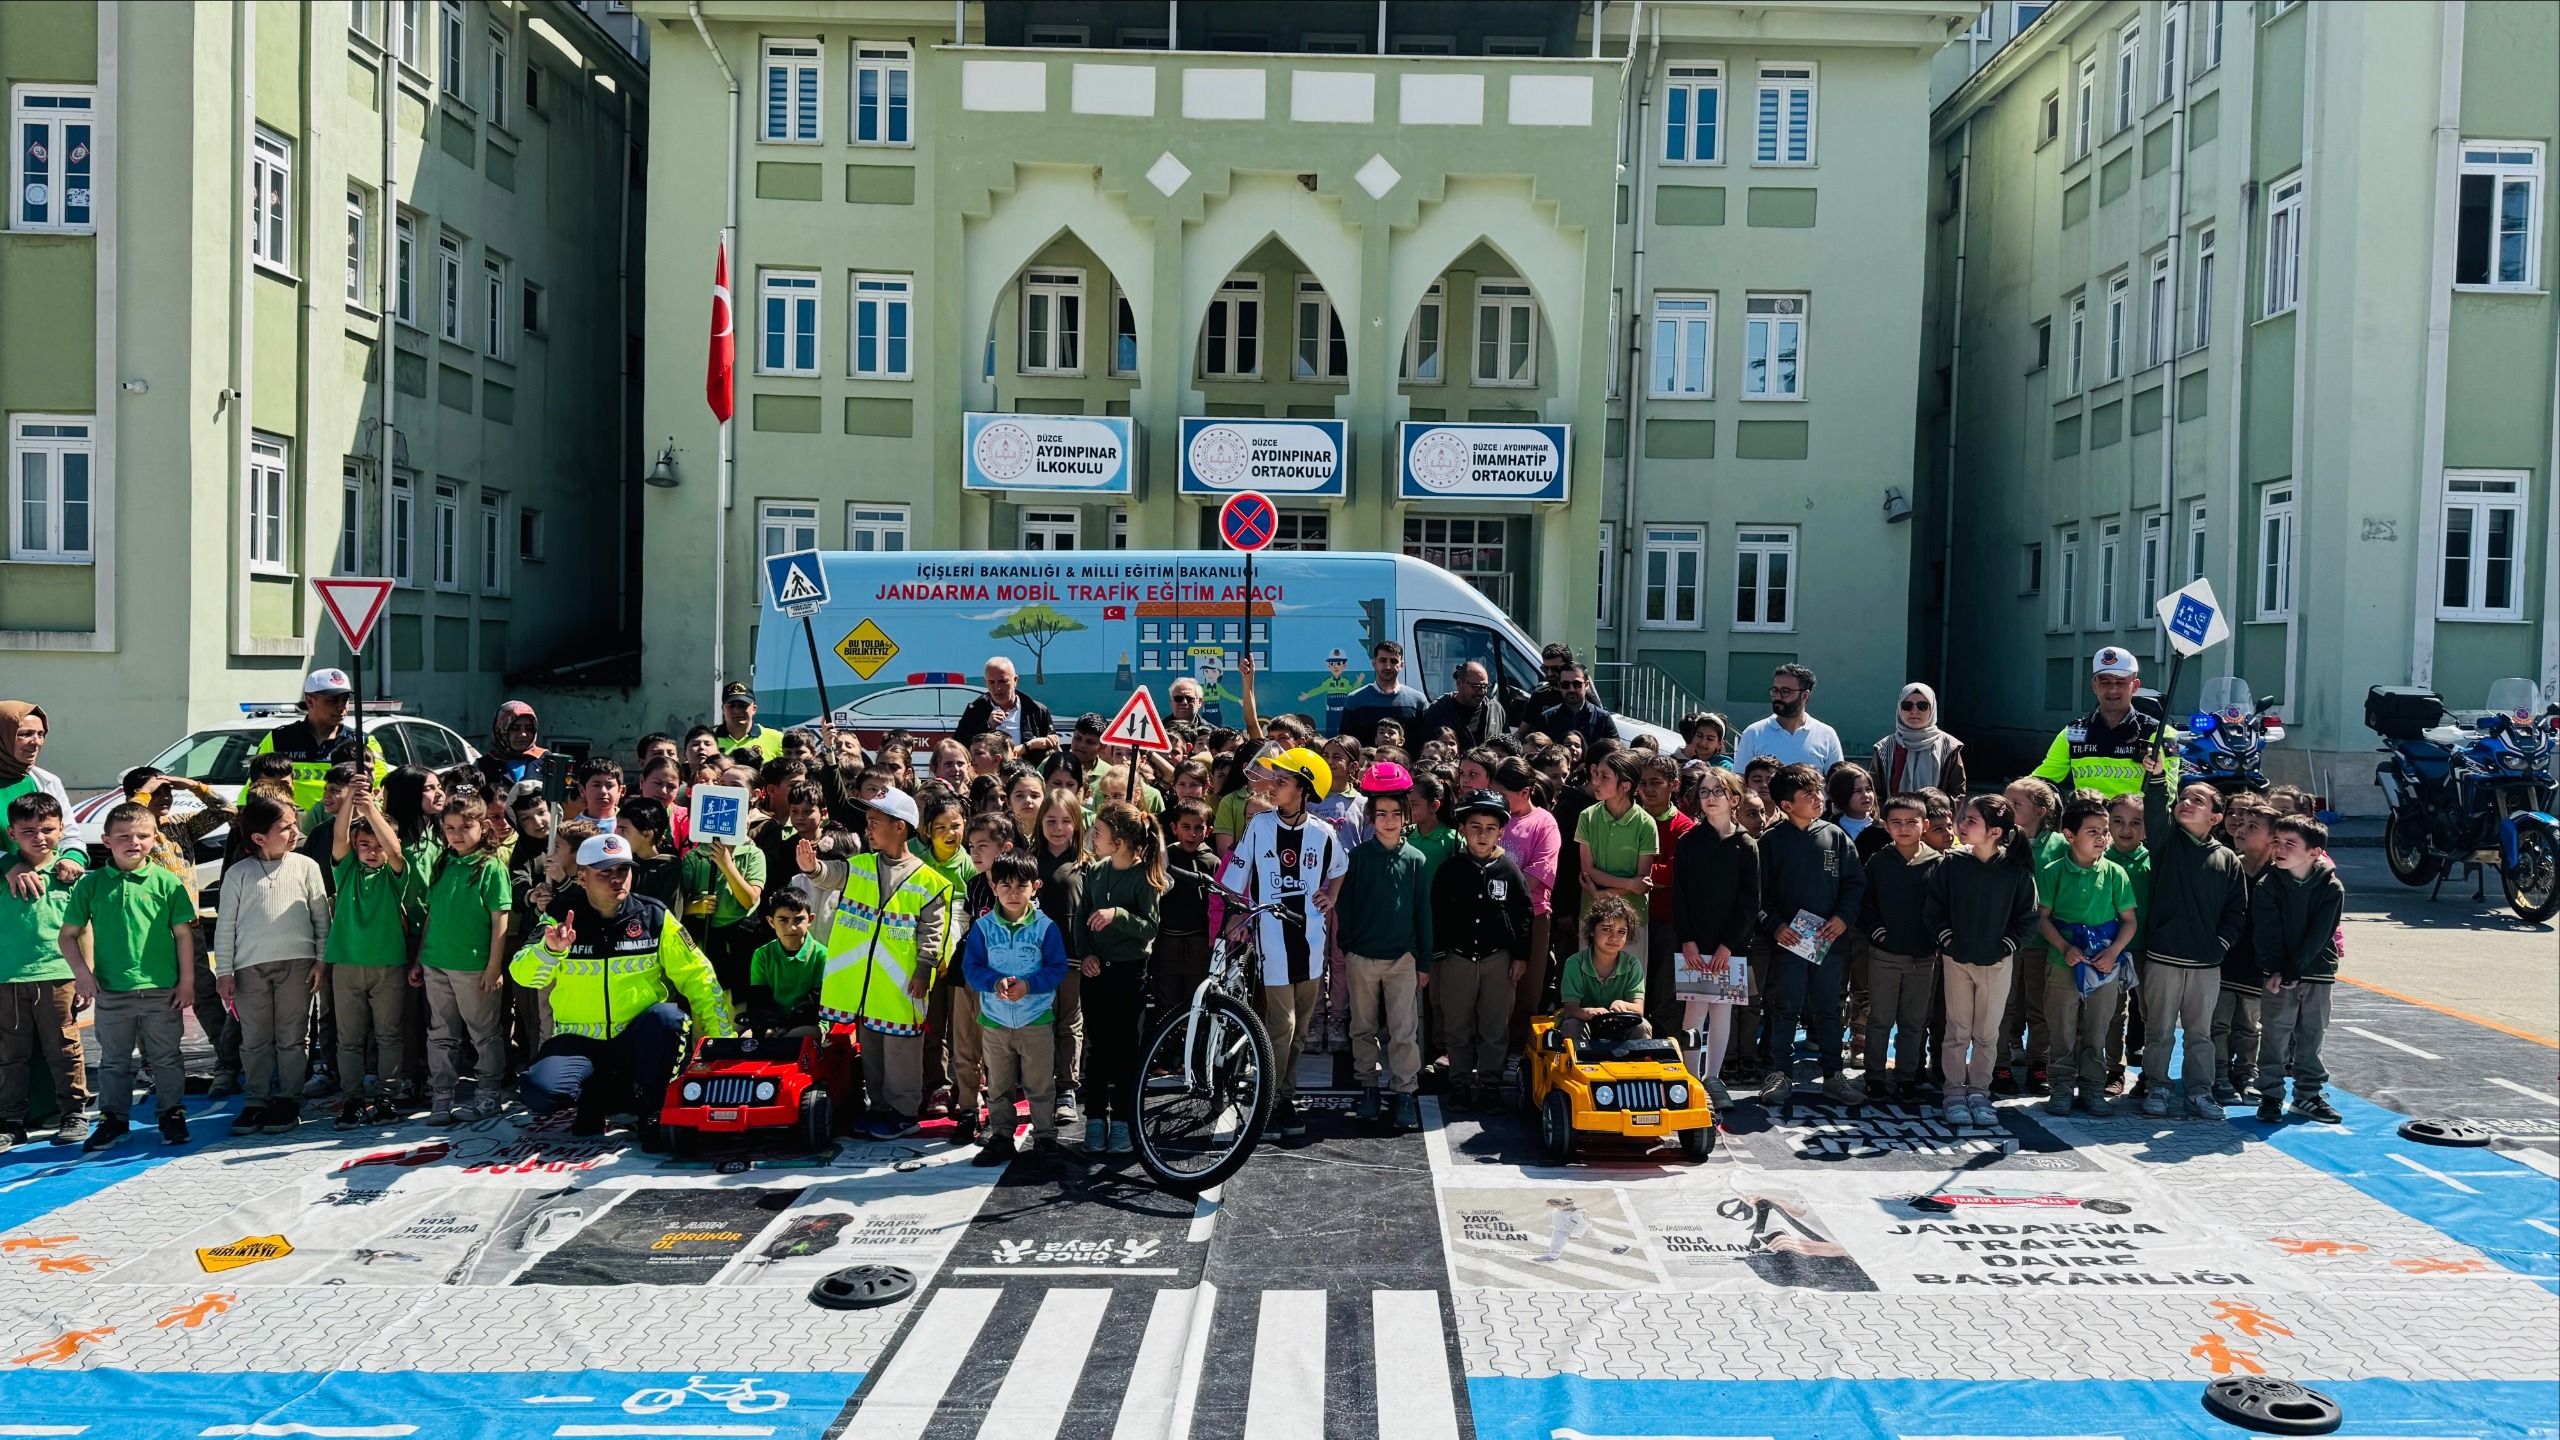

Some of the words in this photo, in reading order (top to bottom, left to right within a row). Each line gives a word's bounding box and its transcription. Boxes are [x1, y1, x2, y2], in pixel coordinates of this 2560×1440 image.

[1037, 434, 1063, 443] DÜZCE
[1252, 438, 1278, 447] DÜZCE
[1036, 445, 1117, 459] AYDINPINAR
[1473, 442, 1498, 451] DÜZCE
[1503, 444, 1549, 452] AYDINPINAR
[1252, 449, 1332, 463] AYDINPINAR
[1472, 451, 1547, 466] İMAMHATİP
[1036, 458, 1103, 474] İLKOKULU
[1251, 465, 1332, 479] ORTAOKULU
[1472, 469, 1553, 483] ORTAOKULU
[917, 563, 974, 580] İÇİŞLERİ
[980, 564, 1060, 577] BAKANLIĞI
[1066, 566, 1075, 577] &
[1081, 563, 1119, 578] MİLLİ
[1125, 563, 1174, 578] EĞİTİM
[875, 584, 990, 601] JANDARMA
[997, 581, 1060, 601] MOBİL
[1067, 581, 1140, 601] TRAFİK
[1147, 581, 1214, 601] EĞİTİM
[1221, 584, 1283, 601] ARACI
[848, 640, 859, 648] BU
[860, 640, 885, 648] YOLDA
[2072, 744, 2098, 753] TRFİK
[418, 1216, 457, 1225] YAYA
[1462, 1215, 1500, 1223] YAYA
[403, 1224, 479, 1234] YOLUNDA
[1886, 1222, 2167, 1235] JANDARMA
[661, 1231, 743, 1241] GÖRÜNÜR
[899, 1236, 921, 1244] ET
[1464, 1230, 1529, 1241] KULLAN
[1662, 1235, 1709, 1245] YOLA
[650, 1240, 676, 1250] OL
[1044, 1238, 1115, 1251] yaya
[1667, 1244, 1751, 1253] ODAKLAN
[1943, 1237, 2144, 1251] TRAFİK
[1035, 1251, 1110, 1264] önce
[1980, 1253, 2146, 1267] DAİRE
